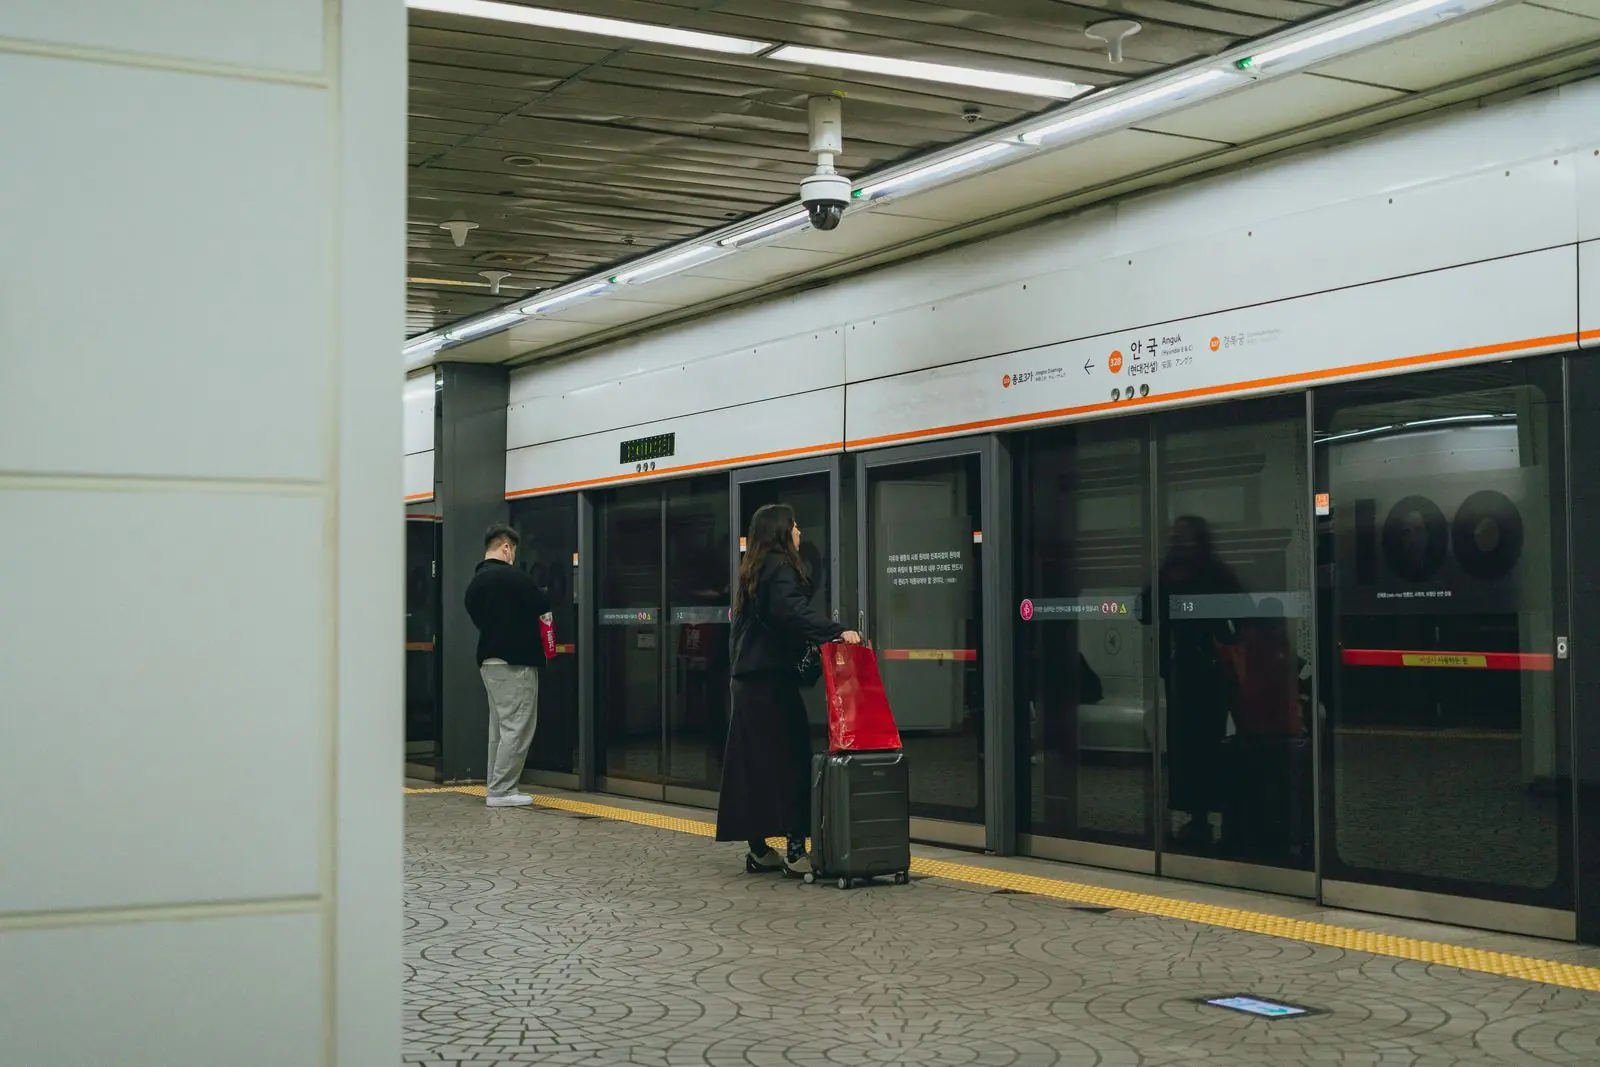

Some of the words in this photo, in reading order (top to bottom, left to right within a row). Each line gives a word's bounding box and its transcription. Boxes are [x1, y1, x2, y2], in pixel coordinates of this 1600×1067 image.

[1162, 333, 1182, 346] Anguk
[1128, 361, 1158, 376] (현대건설)
[1012, 371, 1033, 385] 종로3가
[1183, 602, 1194, 612] 1-3
